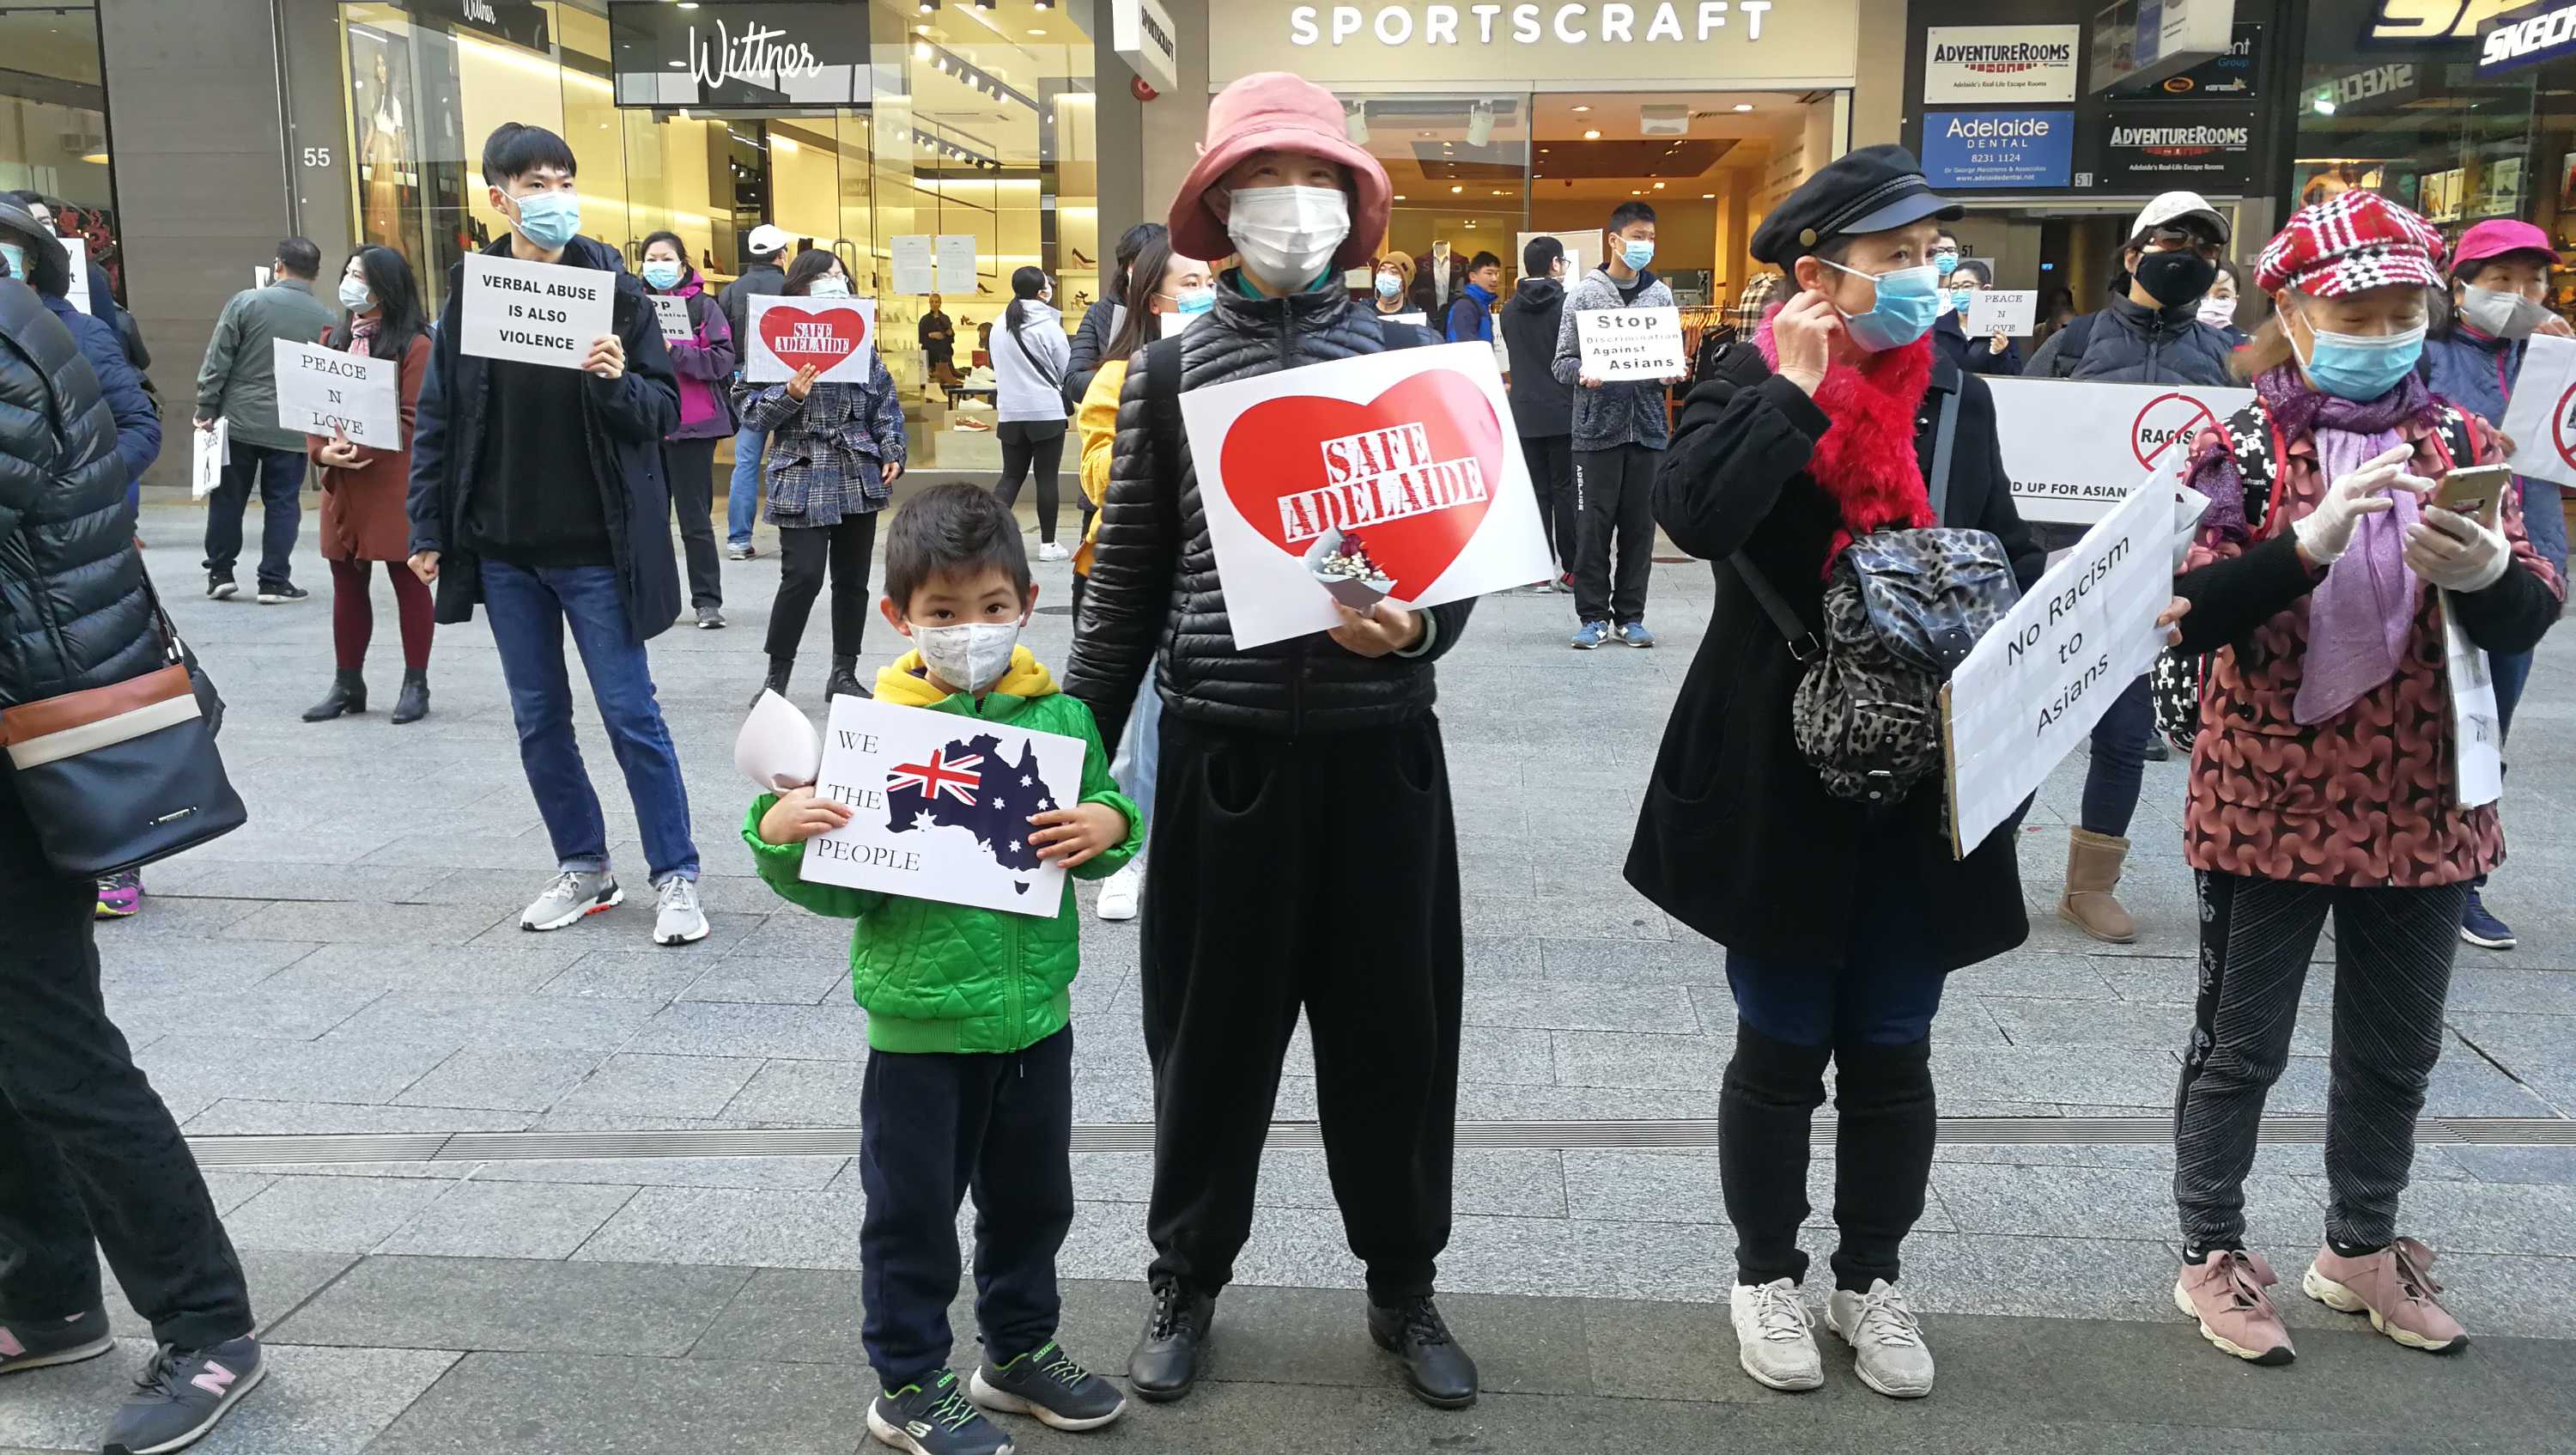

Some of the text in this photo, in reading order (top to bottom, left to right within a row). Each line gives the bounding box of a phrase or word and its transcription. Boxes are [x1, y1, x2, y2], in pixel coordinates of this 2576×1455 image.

[1290, 1, 1772, 46] SPORTSCRAFT
[690, 19, 823, 88] Wittner
[1946, 119, 2050, 138] Adelaide
[1967, 139, 2028, 149] DENTAL
[304, 148, 331, 167] 55
[1971, 154, 2020, 163] 8231 1124
[2076, 174, 2091, 186] 51
[1961, 245, 1974, 258] 51
[483, 274, 597, 301] VERBAL ABUSE
[1984, 295, 2023, 303] PEACE
[508, 305, 567, 323] IS ALSO
[1597, 315, 1658, 329] Stop
[1997, 310, 2006, 319] N
[793, 323, 833, 337] SAFE
[1586, 333, 1680, 344] Discrimination
[499, 330, 574, 350] VIOLENCE
[776, 337, 849, 354] ADELAIDE
[1593, 345, 1646, 356] Against
[301, 355, 367, 380] PEACE
[1610, 357, 1674, 370] Asians
[327, 389, 342, 404] N
[313, 412, 364, 435] LOVE
[1326, 425, 1430, 485] SAFE
[2027, 482, 2046, 493] UP
[2050, 484, 2079, 496] FOR
[2083, 485, 2127, 497] ASIAN
[1288, 460, 1485, 539] ADELAIDE
[2008, 536, 2129, 667] No Racism
[2058, 632, 2082, 665] to
[2037, 653, 2109, 738] Asians
[838, 730, 878, 754] WE
[828, 783, 882, 810] THE
[817, 838, 921, 871] PEOPLE
